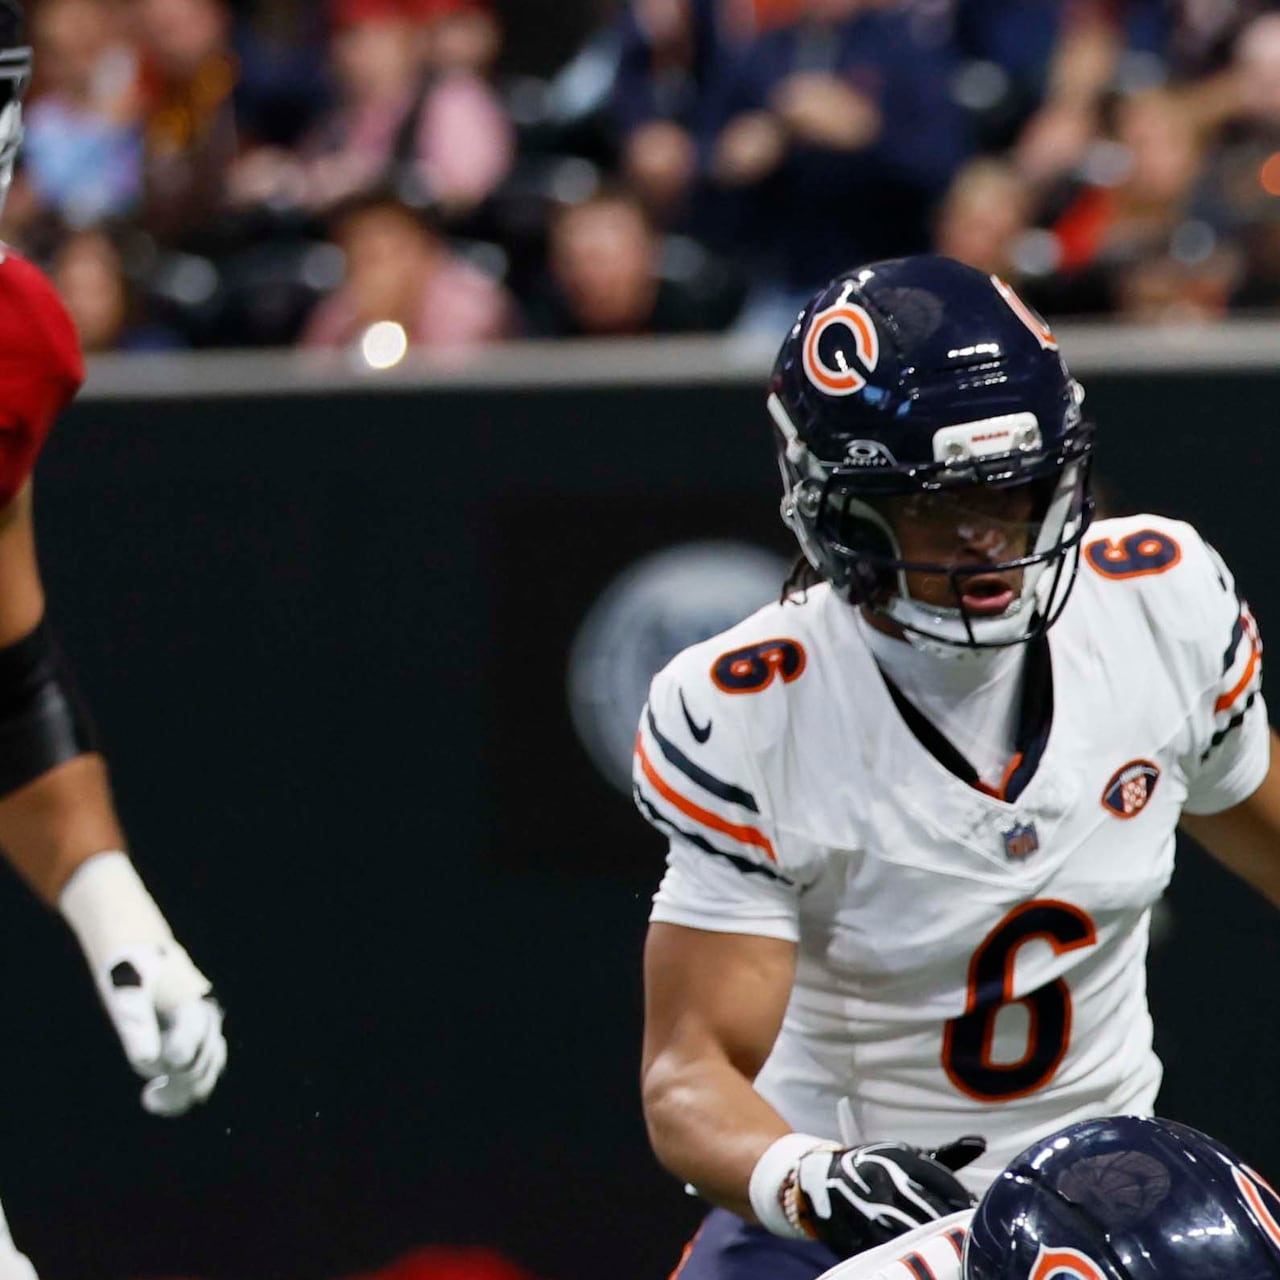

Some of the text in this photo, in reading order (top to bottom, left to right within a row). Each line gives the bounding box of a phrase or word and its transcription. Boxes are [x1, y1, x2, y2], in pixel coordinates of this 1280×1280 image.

[1085, 529, 1182, 581] 6
[710, 637, 806, 694] 6
[941, 898, 1098, 1103] 6
